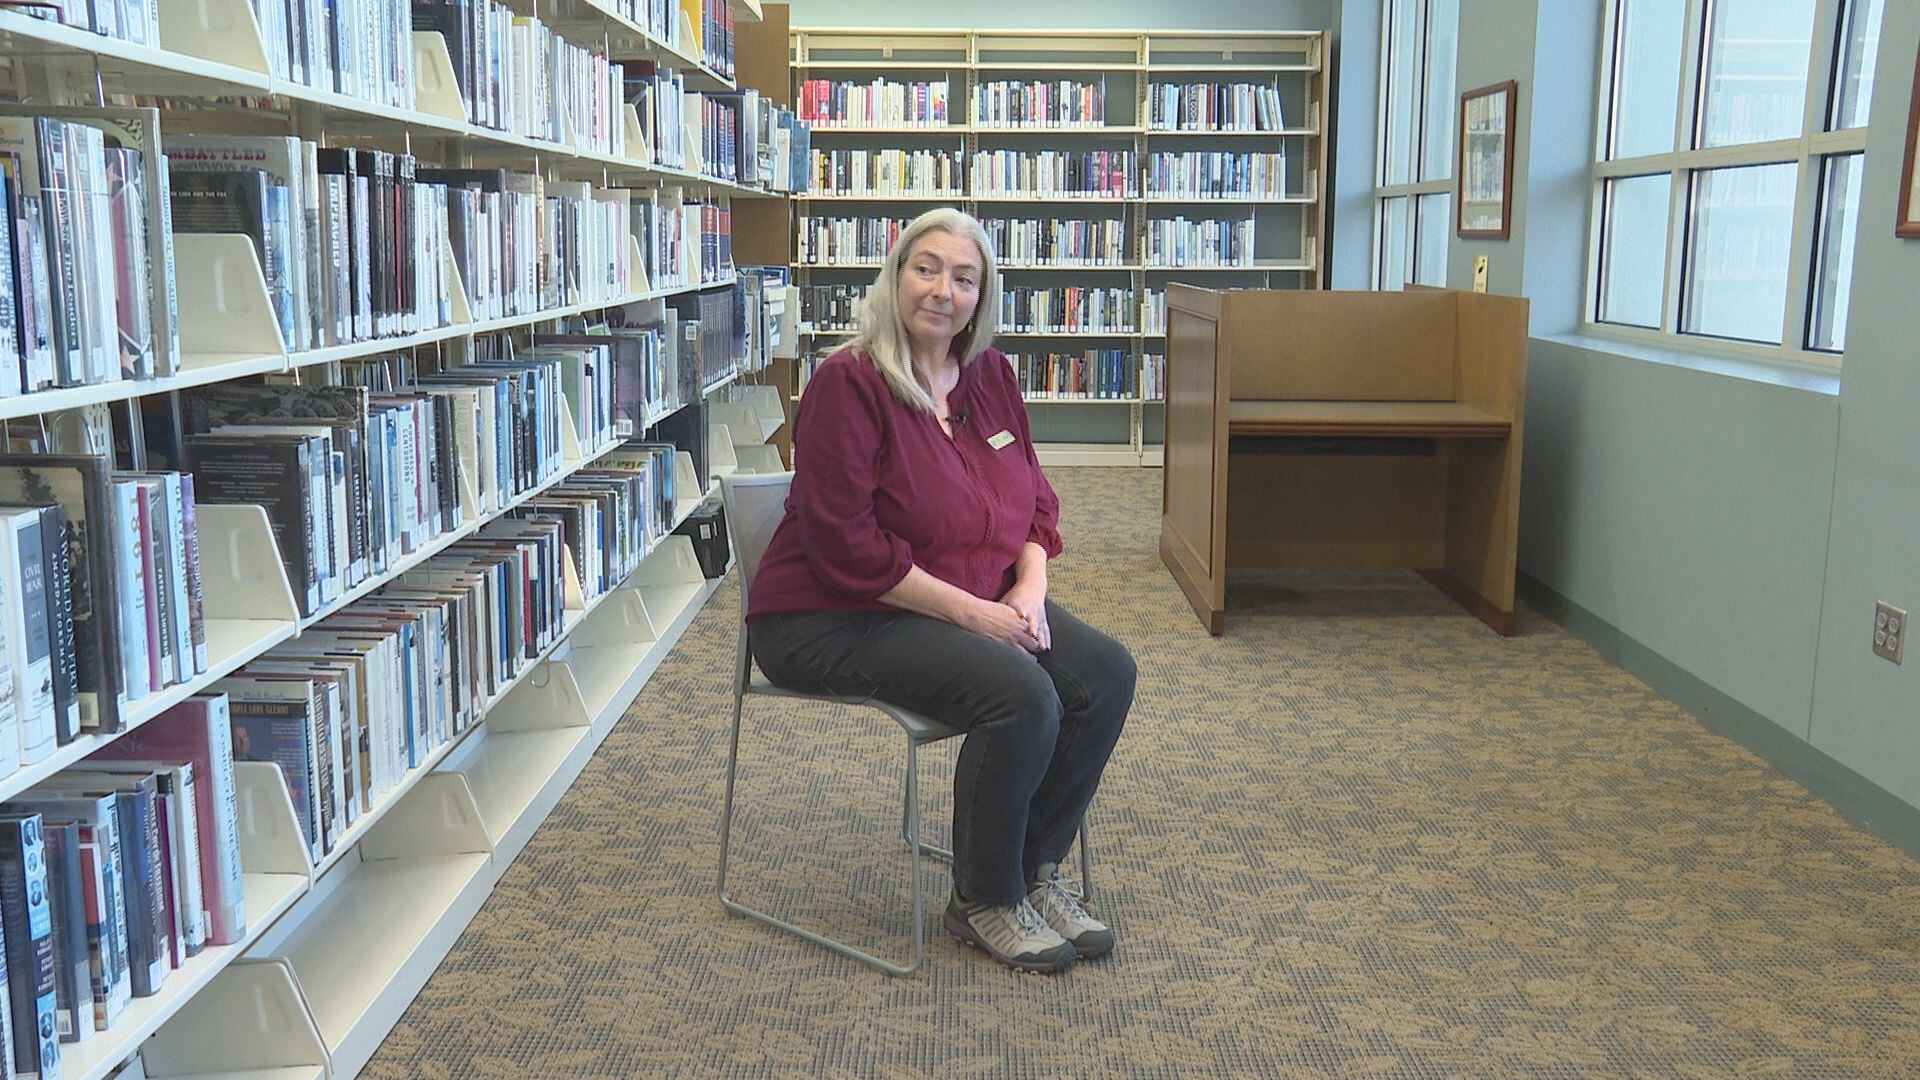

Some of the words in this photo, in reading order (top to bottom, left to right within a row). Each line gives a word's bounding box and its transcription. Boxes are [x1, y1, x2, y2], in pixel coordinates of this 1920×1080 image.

[330, 182, 340, 268] IMPEACHED
[67, 285, 77, 346] Leaders
[59, 525, 68, 538] A
[60, 540, 73, 613] WORLD
[158, 567, 166, 609] FATEFUL
[52, 552, 62, 607] AMANDA
[57, 612, 67, 676] FOREMAN
[66, 618, 75, 646] ON
[160, 612, 169, 657] LIGHTNIN
[68, 653, 80, 699] FIRE
[219, 723, 230, 807] COMPLETE
[226, 808, 234, 846] CIVIL
[230, 849, 238, 882] WAR
[149, 790, 157, 828] BATTLE
[154, 862, 165, 913] FREEDOM
